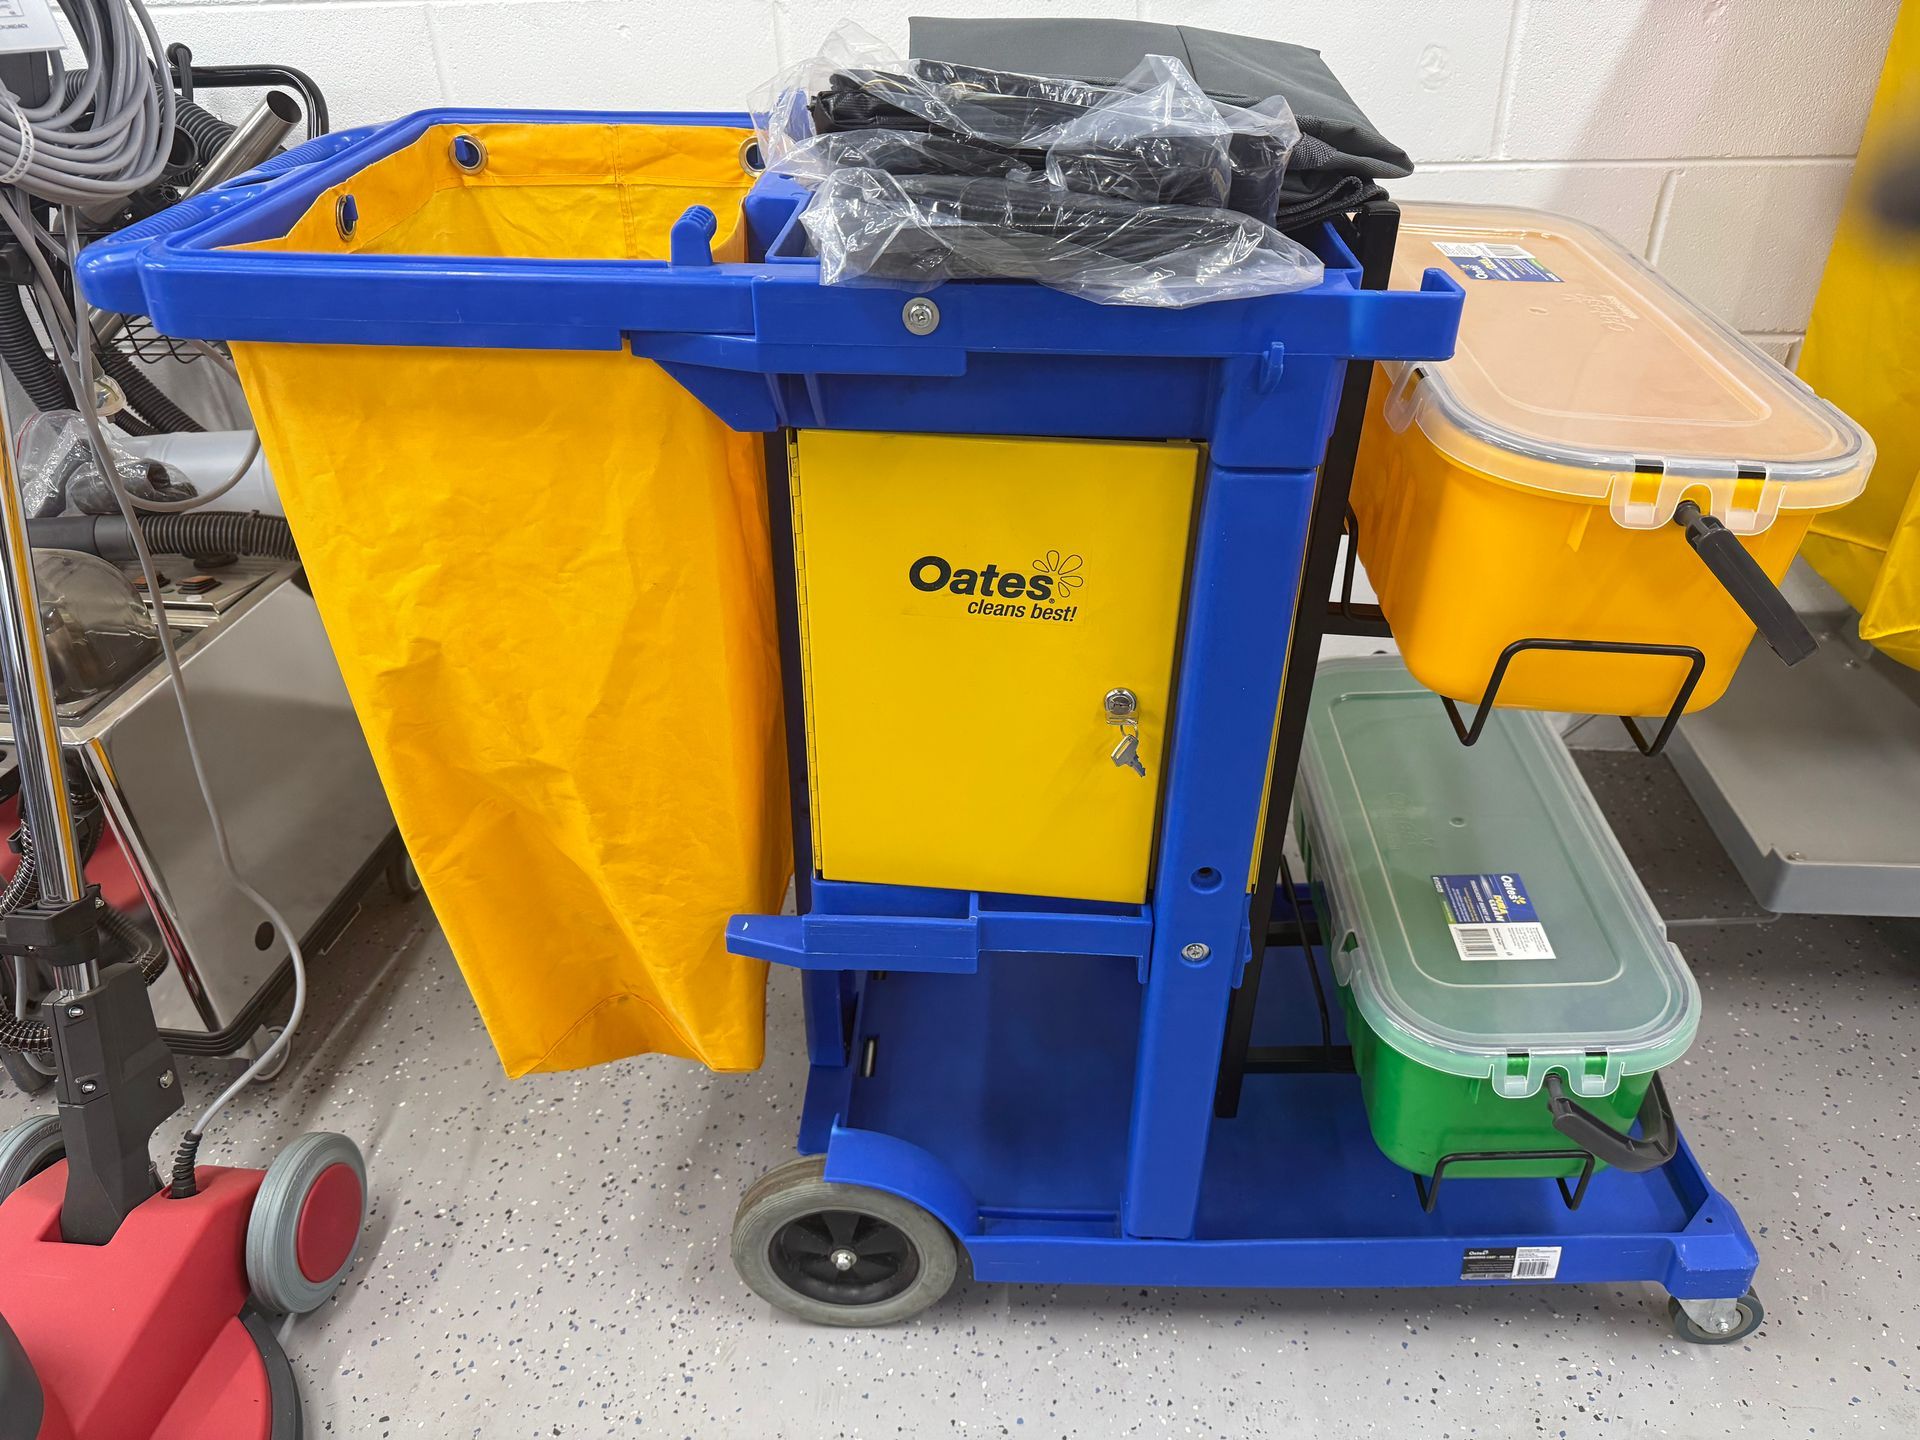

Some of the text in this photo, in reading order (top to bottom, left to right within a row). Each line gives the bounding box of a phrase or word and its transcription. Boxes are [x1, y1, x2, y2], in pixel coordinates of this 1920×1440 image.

[909, 555, 1053, 601] Oates
[967, 599, 1078, 622] cleans best!
[1501, 875, 1517, 899] Oates
[1489, 899, 1504, 921] CLEAN
